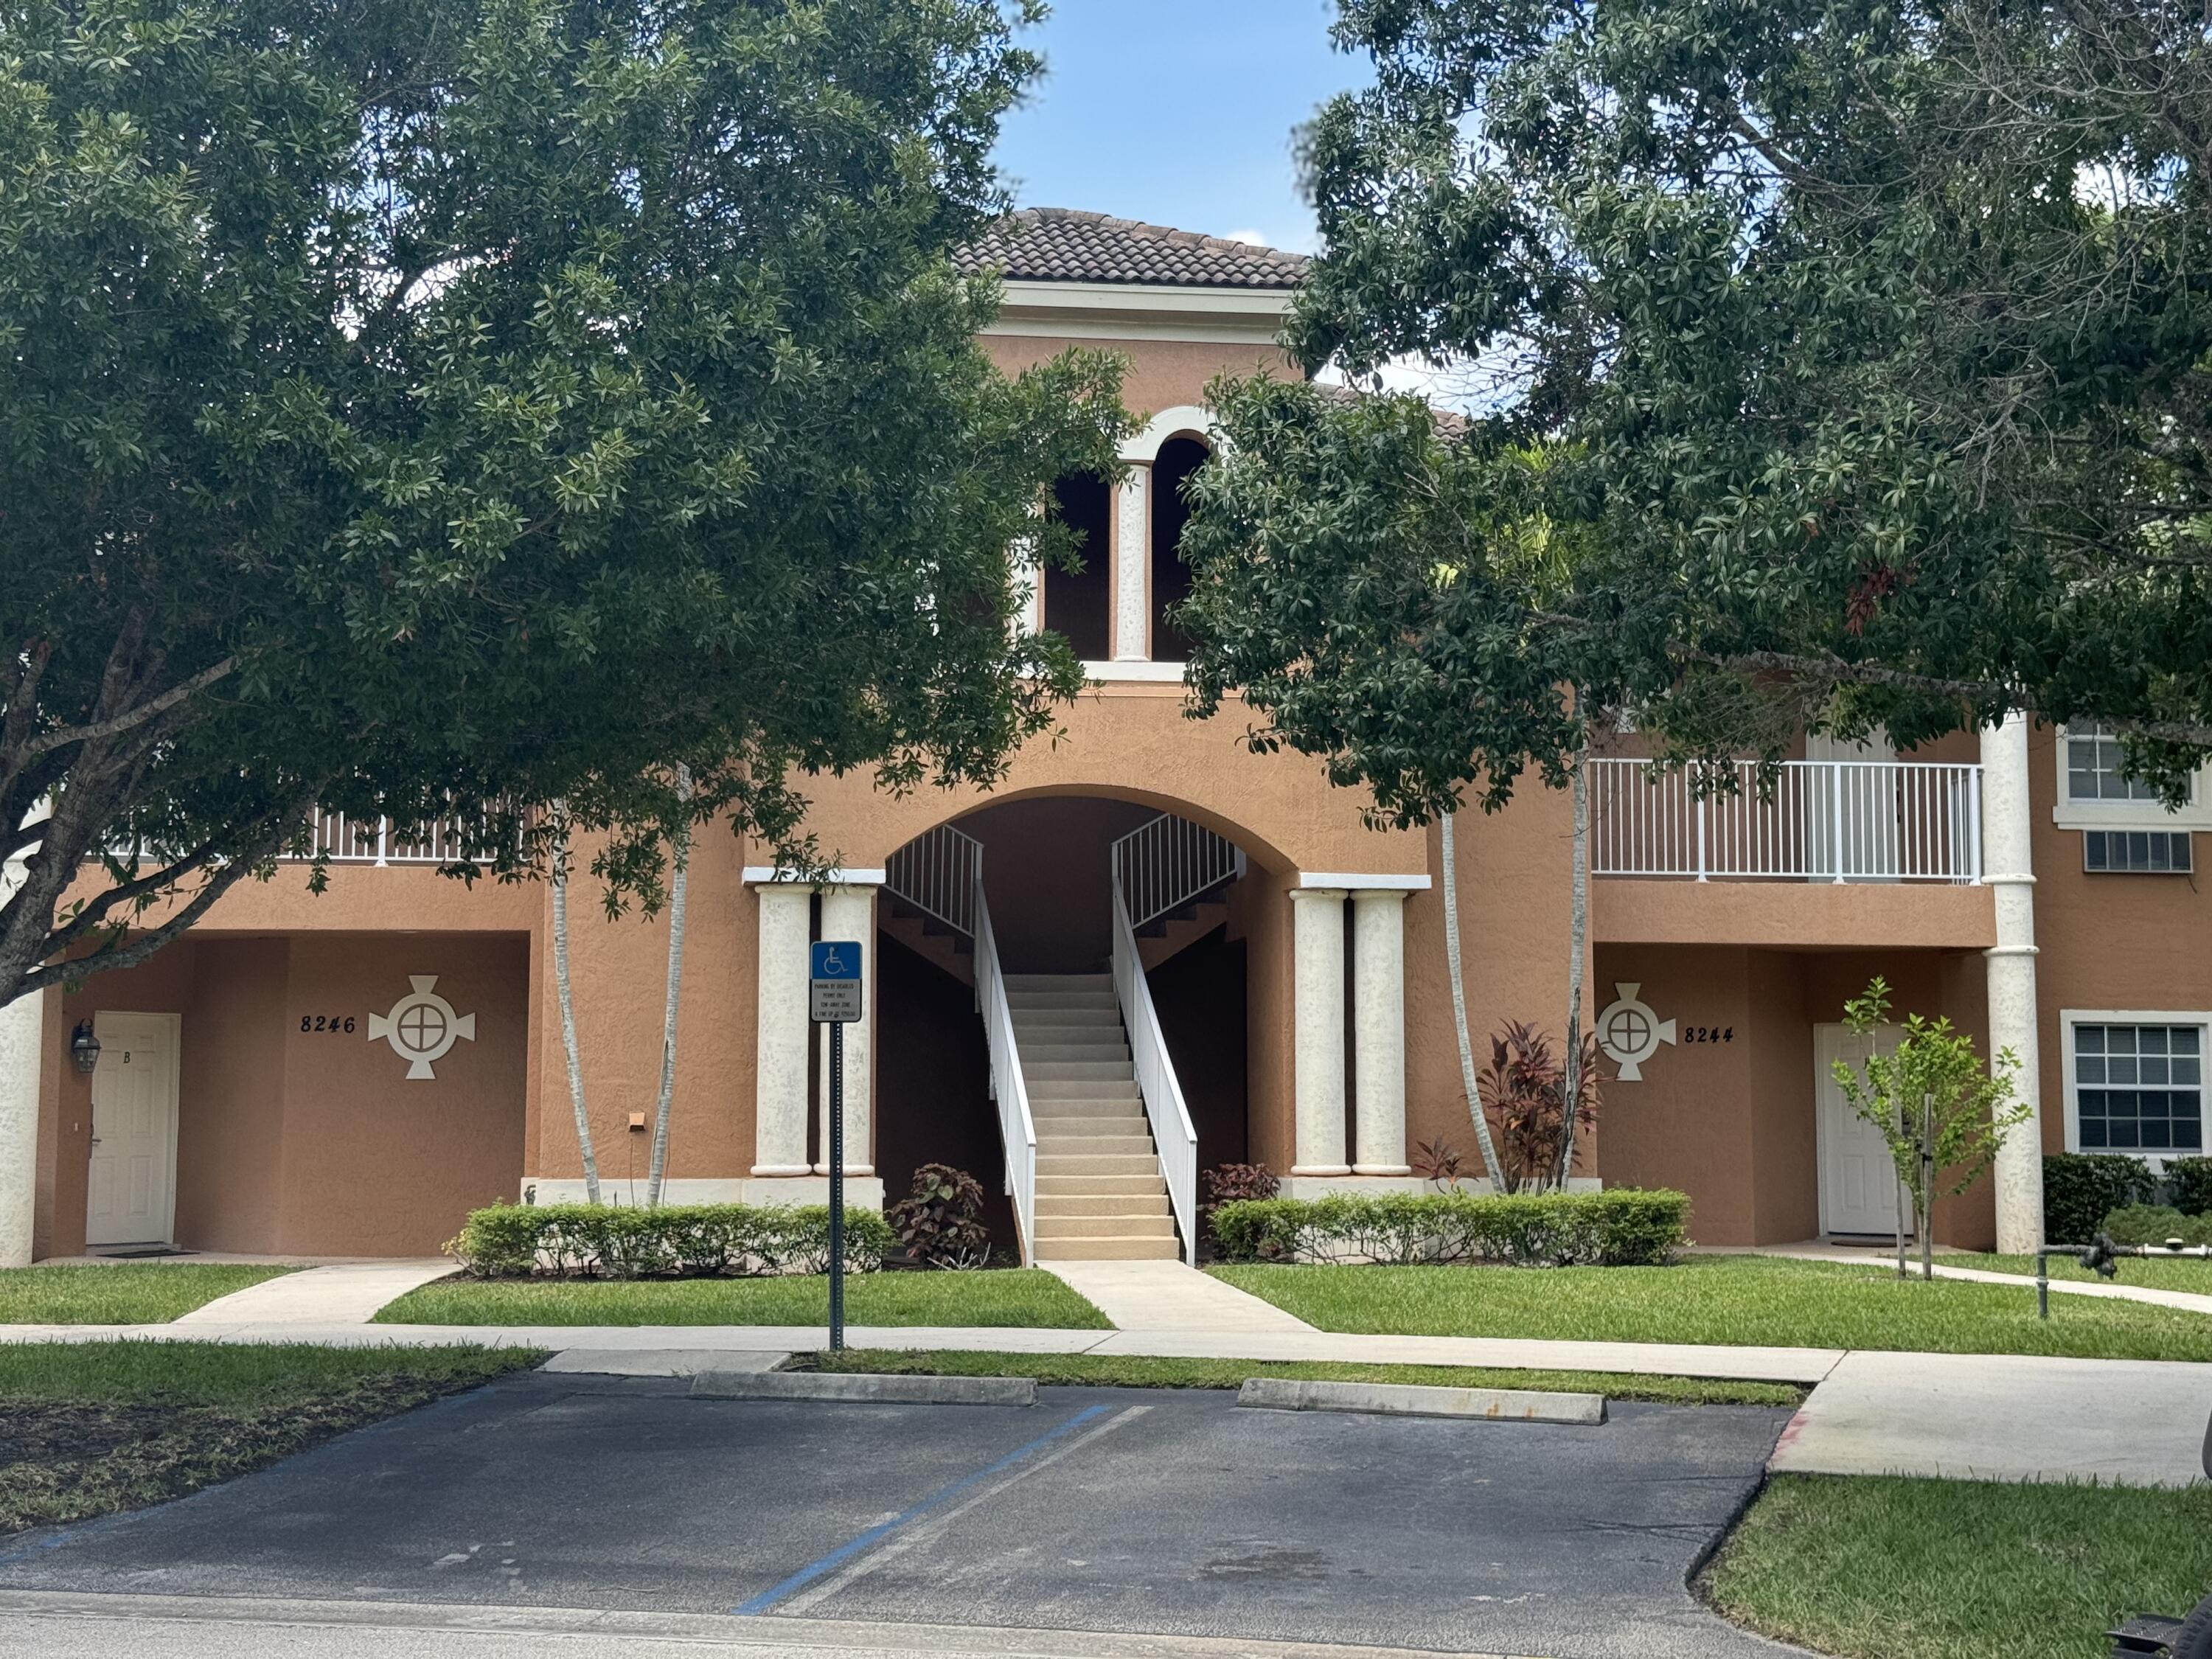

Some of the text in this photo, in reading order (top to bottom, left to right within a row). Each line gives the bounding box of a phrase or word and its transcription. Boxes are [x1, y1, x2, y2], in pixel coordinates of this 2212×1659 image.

[301, 1016, 355, 1034] 8246
[1685, 1026, 1733, 1043] 8244
[124, 1051, 130, 1063] B
